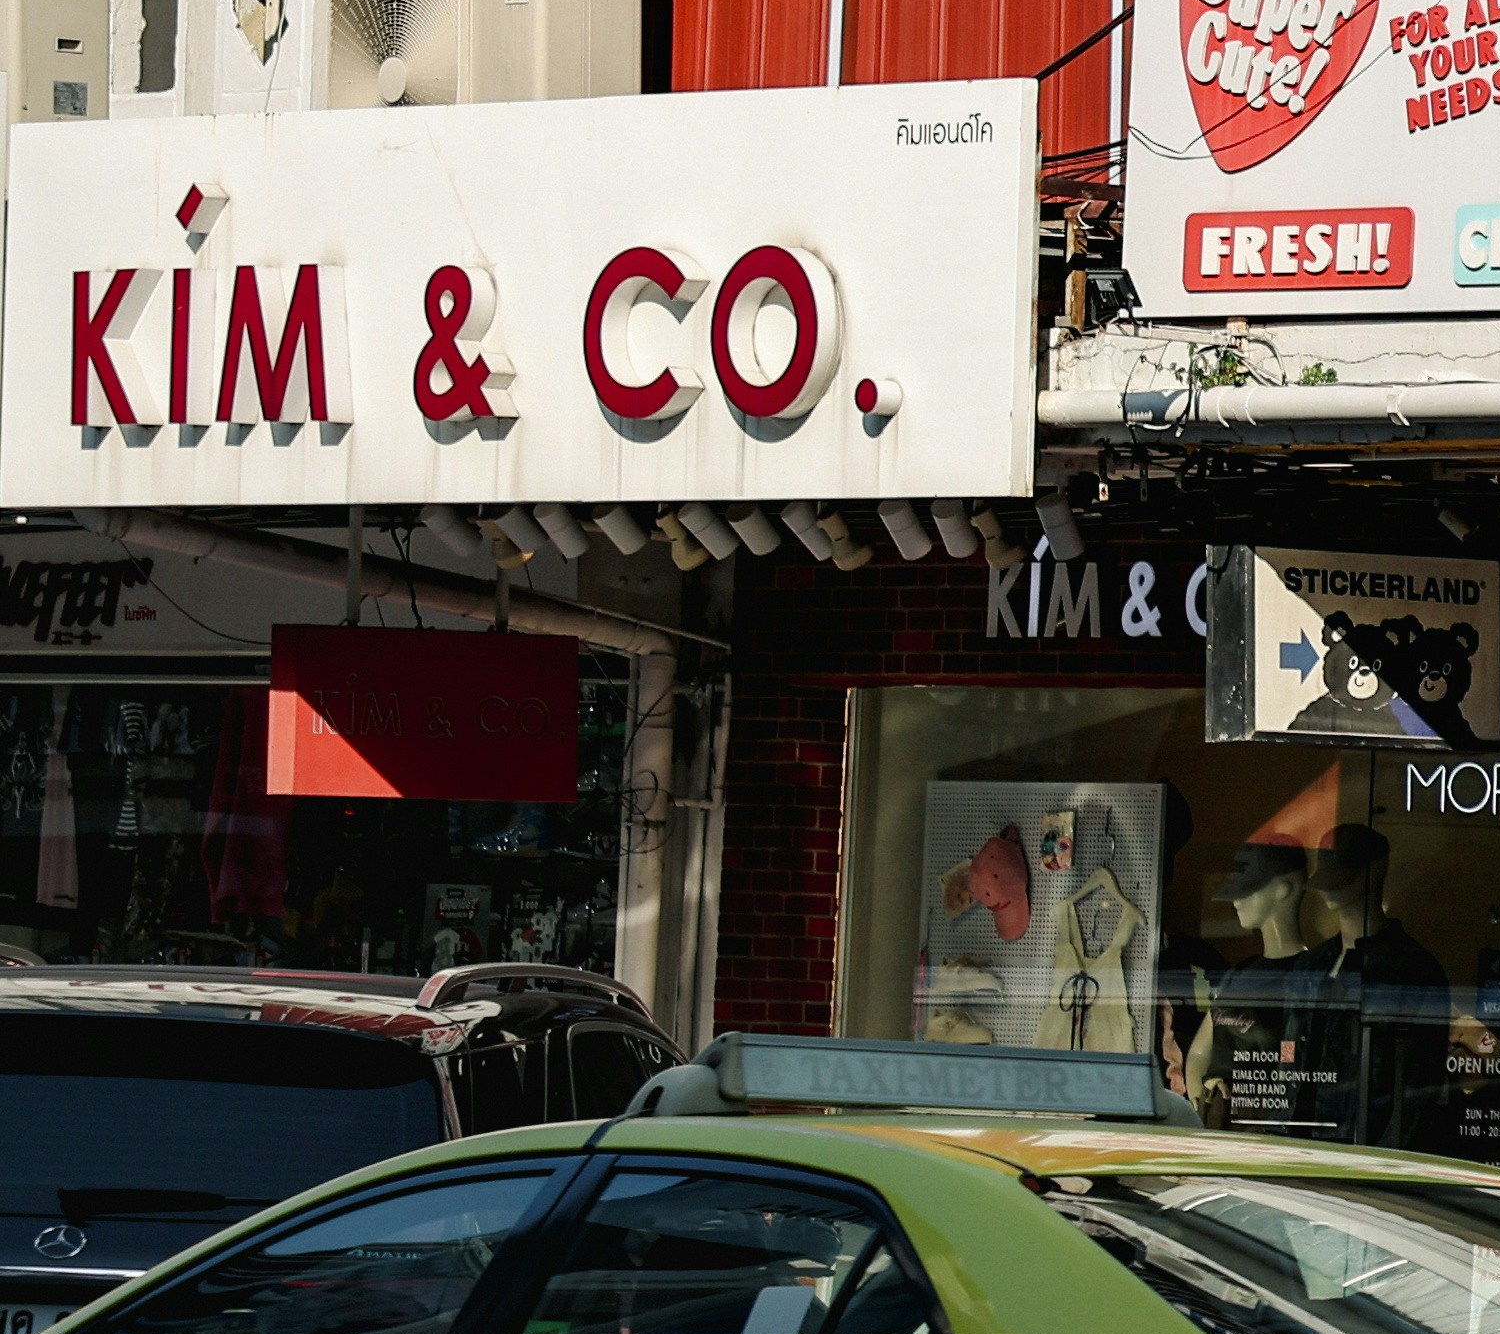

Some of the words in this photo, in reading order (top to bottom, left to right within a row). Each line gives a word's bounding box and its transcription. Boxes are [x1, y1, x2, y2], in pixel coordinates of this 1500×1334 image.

[1388, 4, 1449, 55] FOR
[1186, 10, 1333, 114] Cute!
[1408, 29, 1500, 88] YOUR
[1199, 222, 1393, 277] FRESH!
[413, 264, 500, 422] &
[583, 244, 882, 421] CO.
[1121, 561, 1163, 638] &
[1283, 566, 1482, 606] STICKERLAND
[423, 696, 455, 739] &
[474, 696, 566, 743] CO.
[1233, 1050, 1251, 1063] 2ND
[1252, 1050, 1280, 1064] FLOOR
[1446, 1055, 1482, 1075] OPEN
[1232, 1083, 1254, 1095] MULTI
[1255, 1083, 1287, 1097] BRAND
[1312, 1070, 1338, 1085] STORE
[1231, 1098, 1260, 1111] FITTING
[1261, 1097, 1290, 1111] ROOM
[1465, 1108, 1482, 1120] SUN
[1458, 1123, 1482, 1138] 11:00
